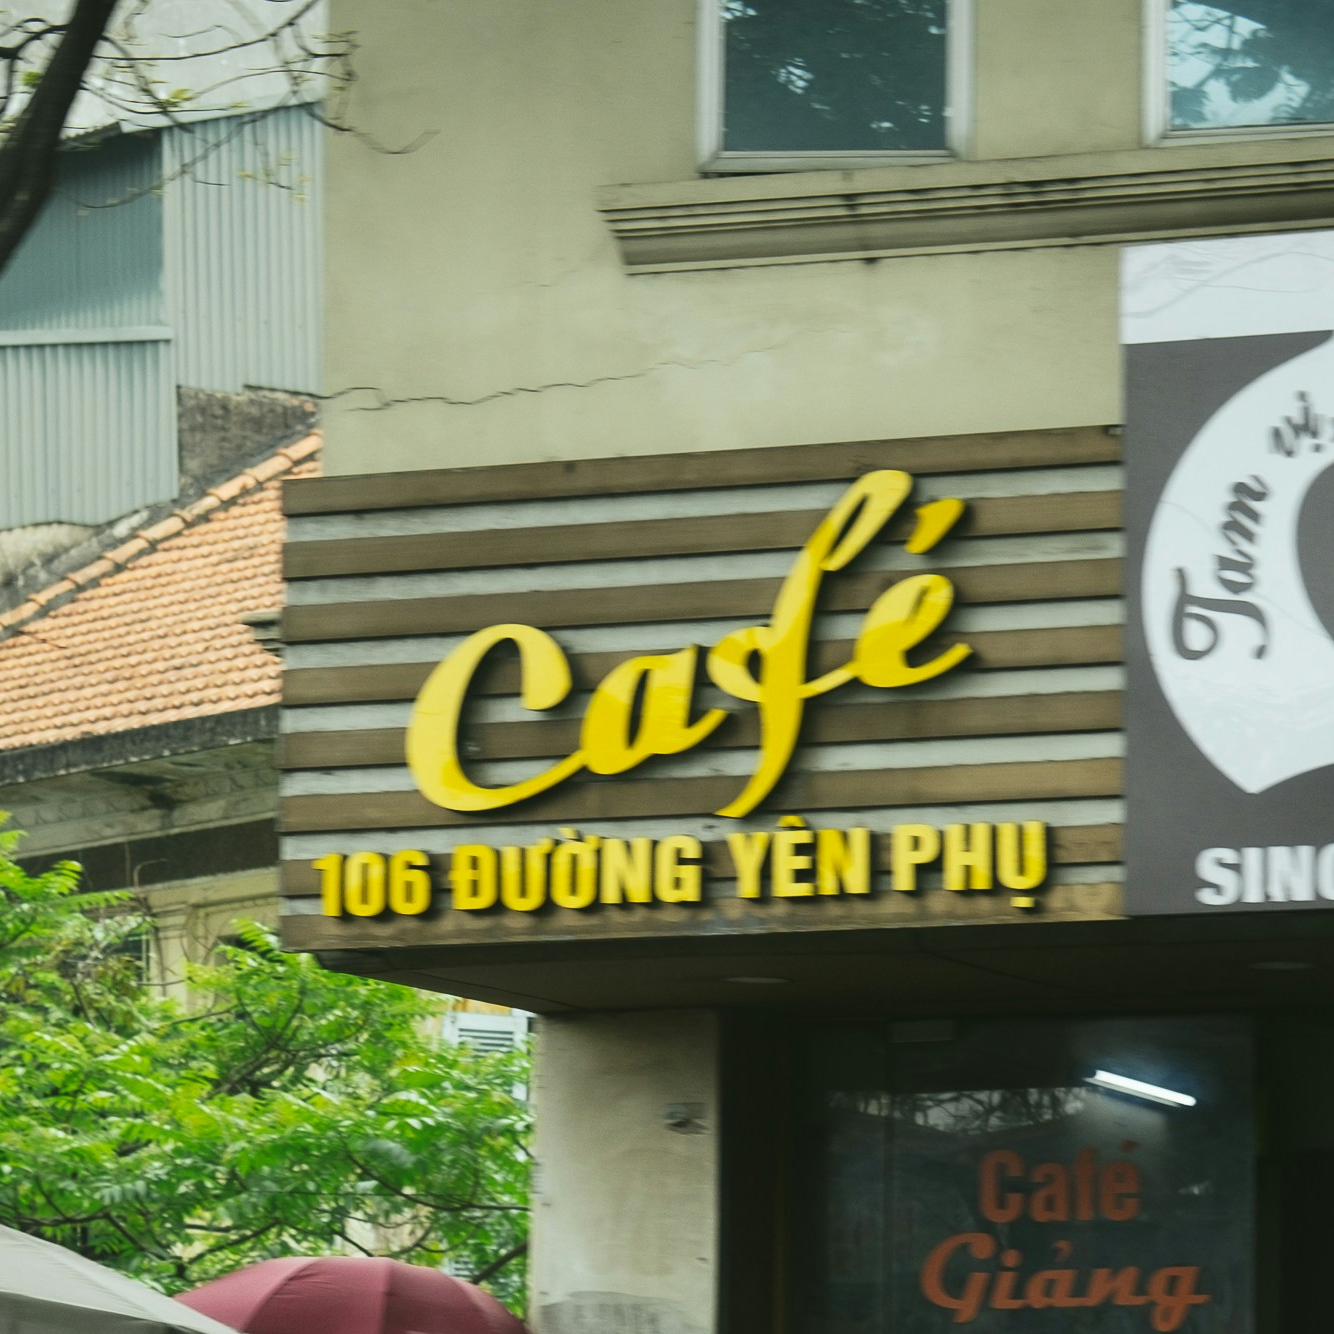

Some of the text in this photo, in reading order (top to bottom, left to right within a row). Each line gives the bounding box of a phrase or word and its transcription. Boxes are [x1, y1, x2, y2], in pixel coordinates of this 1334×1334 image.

[1171, 473, 1270, 661] Tam
[405, 469, 973, 818] Café
[312, 815, 1047, 917] 106 ĐƯỜNG YÊN PHỤ
[979, 1140, 1142, 1223] Café
[919, 1232, 1212, 1332] Giảng
